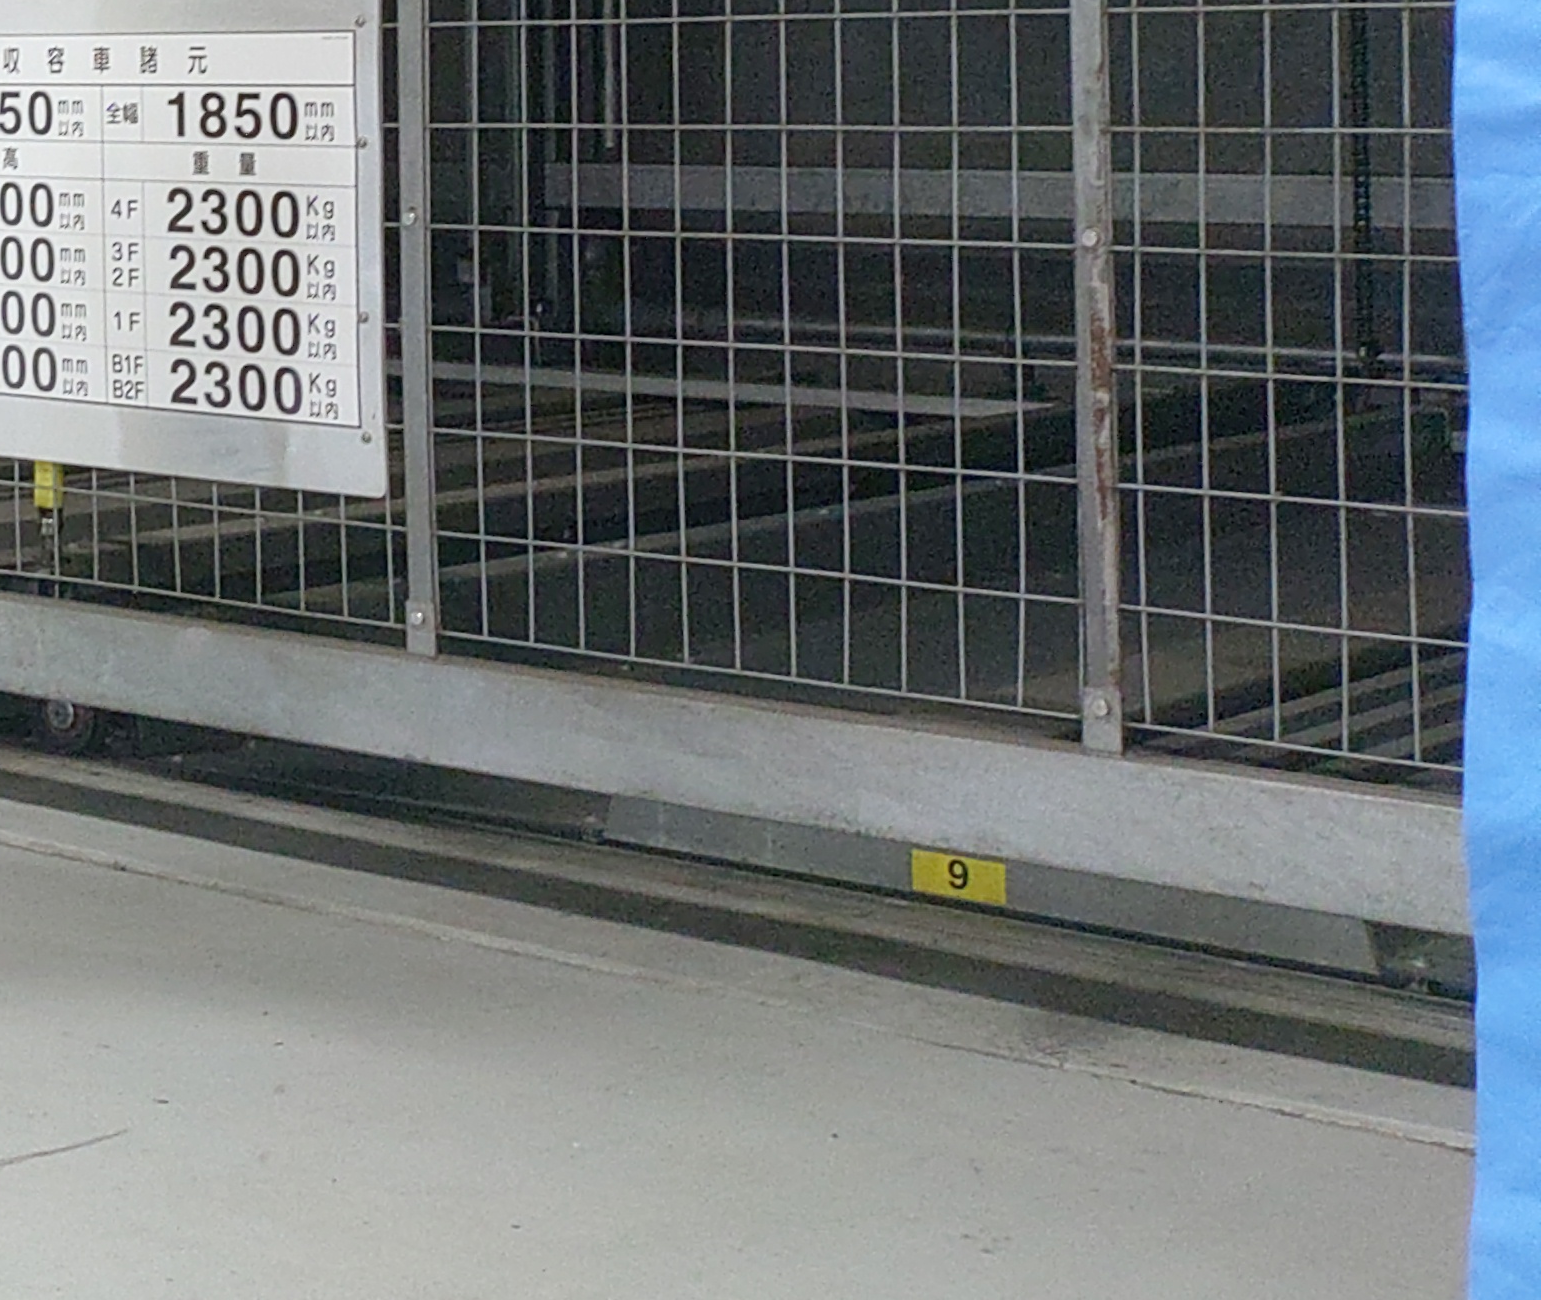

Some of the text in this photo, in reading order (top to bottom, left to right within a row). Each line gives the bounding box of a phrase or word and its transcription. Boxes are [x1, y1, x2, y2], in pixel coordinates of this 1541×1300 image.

[57, 100, 84, 115] mm
[106, 91, 334, 140] 全幅 1850 mm
[305, 123, 335, 142] 以内
[192, 150, 257, 176] 重量
[59, 192, 85, 207] mm
[110, 187, 335, 238] 4F 2300 Kg
[60, 247, 86, 263] mm
[111, 241, 139, 262] 3F
[112, 266, 140, 287] 2F
[169, 244, 335, 297] 2300 Kg
[60, 302, 87, 317] mm
[113, 301, 336, 356] 1F 2300 Kg
[61, 358, 88, 374] mm
[112, 353, 144, 375] B1F
[112, 379, 145, 400] B2F
[170, 358, 337, 414] 2300 Kg
[948, 859, 968, 890] 9
